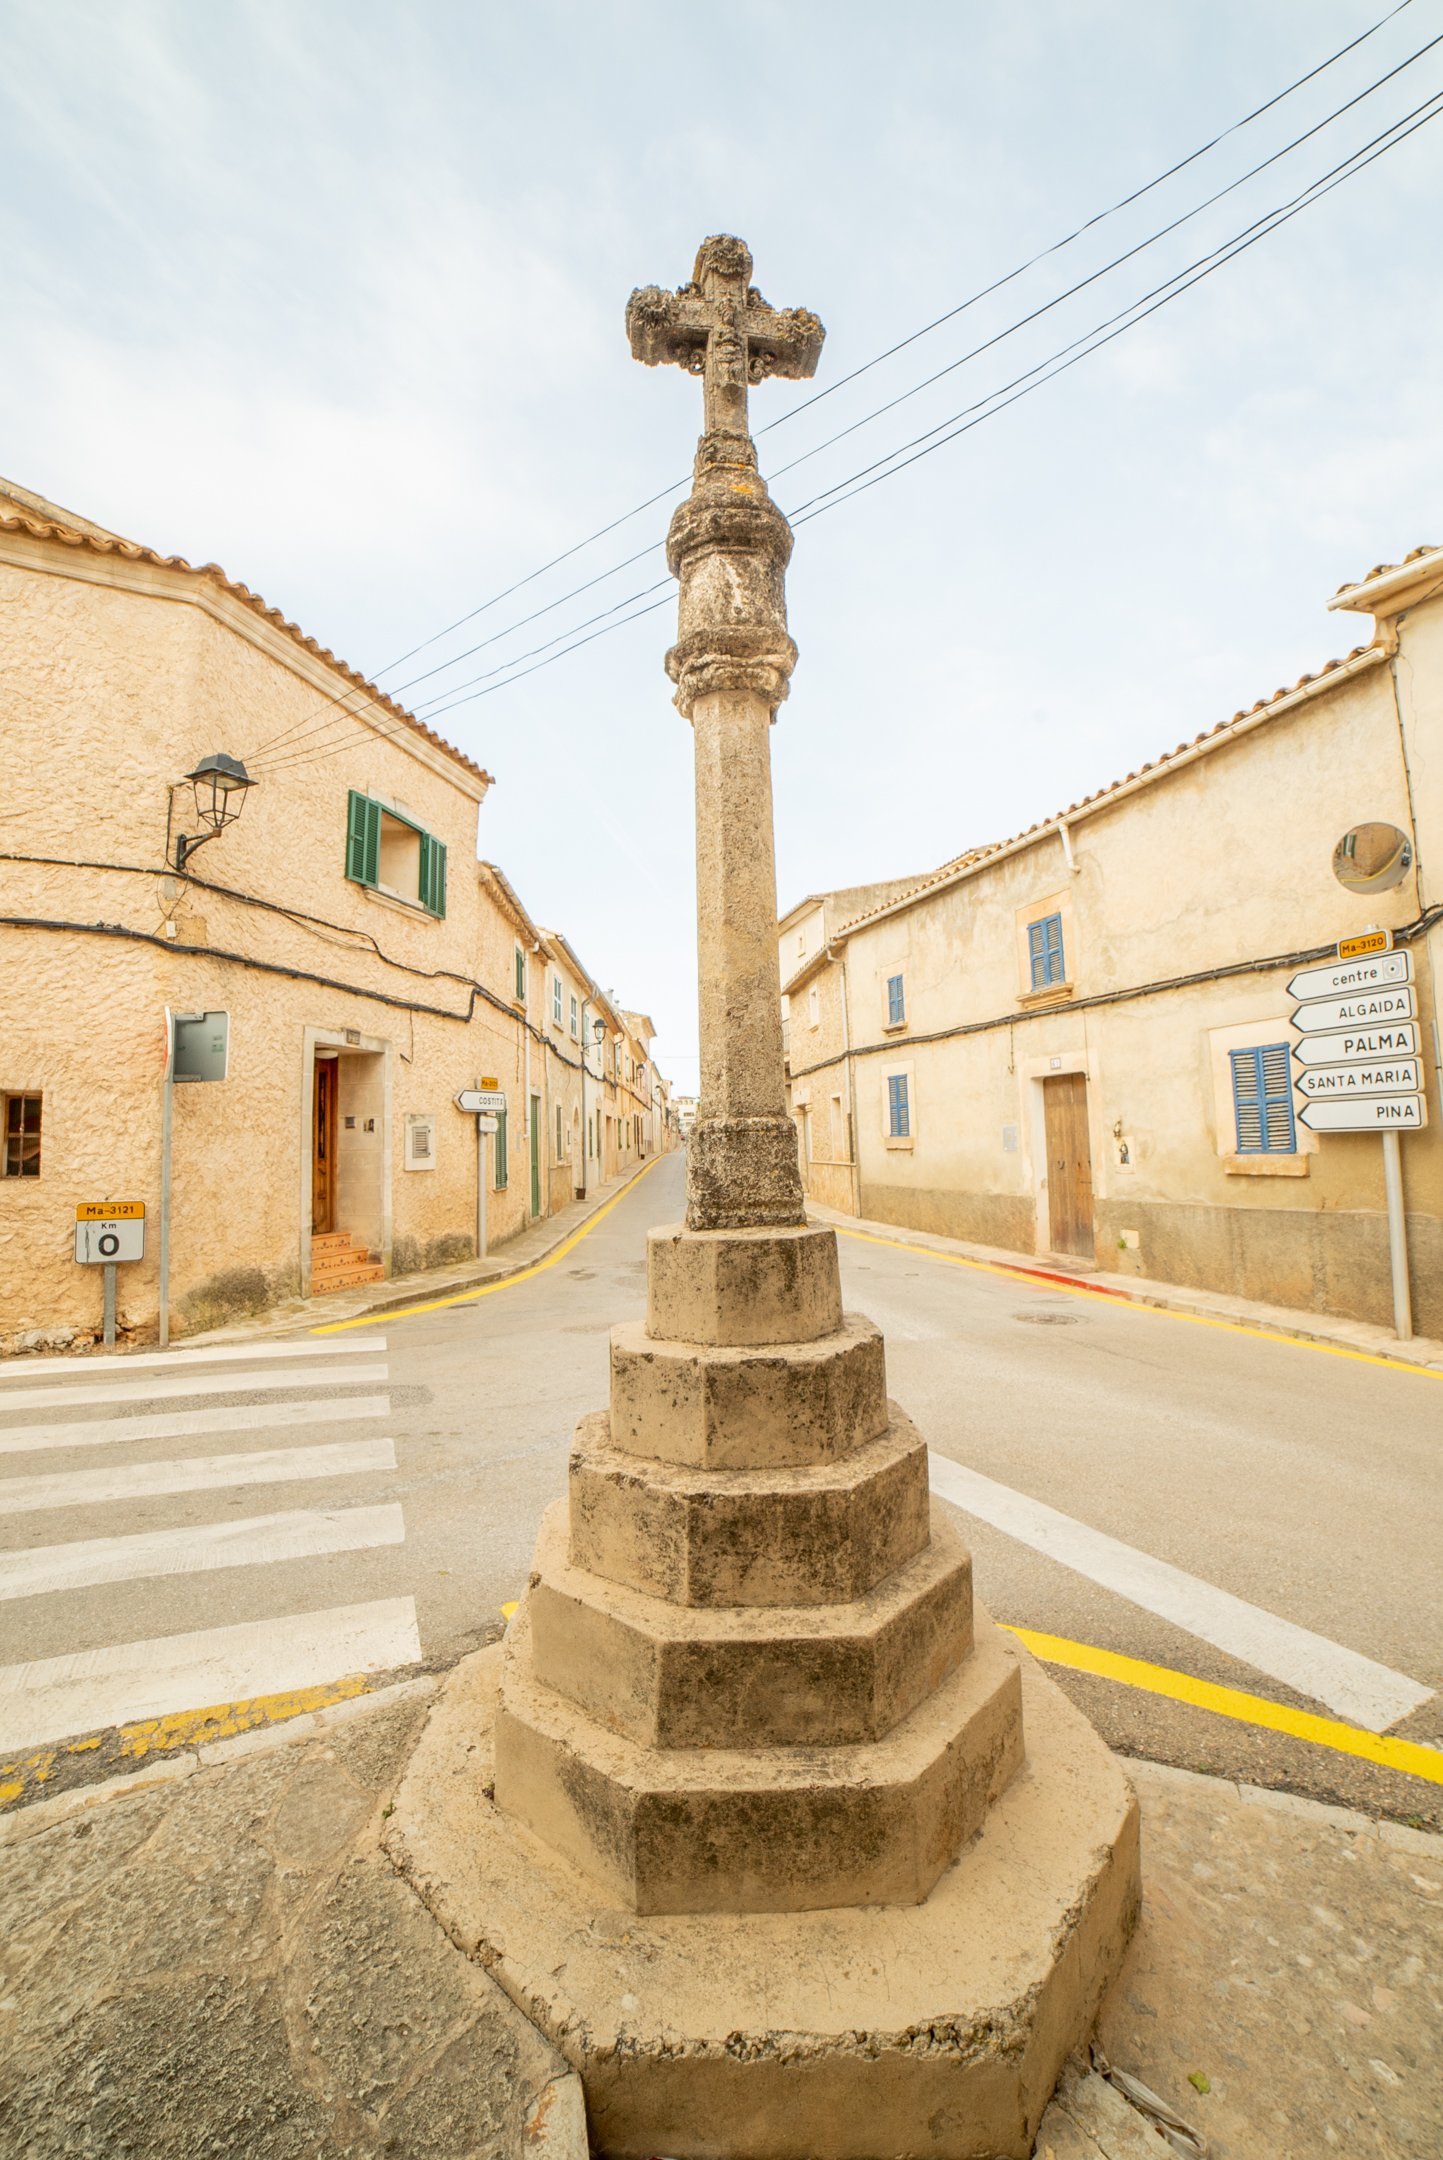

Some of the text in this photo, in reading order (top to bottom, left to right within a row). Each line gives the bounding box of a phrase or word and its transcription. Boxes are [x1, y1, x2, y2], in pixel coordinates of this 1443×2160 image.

[1342, 936, 1384, 953] Ma-3120
[1332, 967, 1378, 986] centre
[1339, 998, 1406, 1019] ALGAIDA
[1344, 1033, 1408, 1054] PALMA
[1307, 1069, 1412, 1090] SANTA MARIA
[1376, 1105, 1415, 1118] PINA
[86, 1205, 134, 1215] Ma-3121
